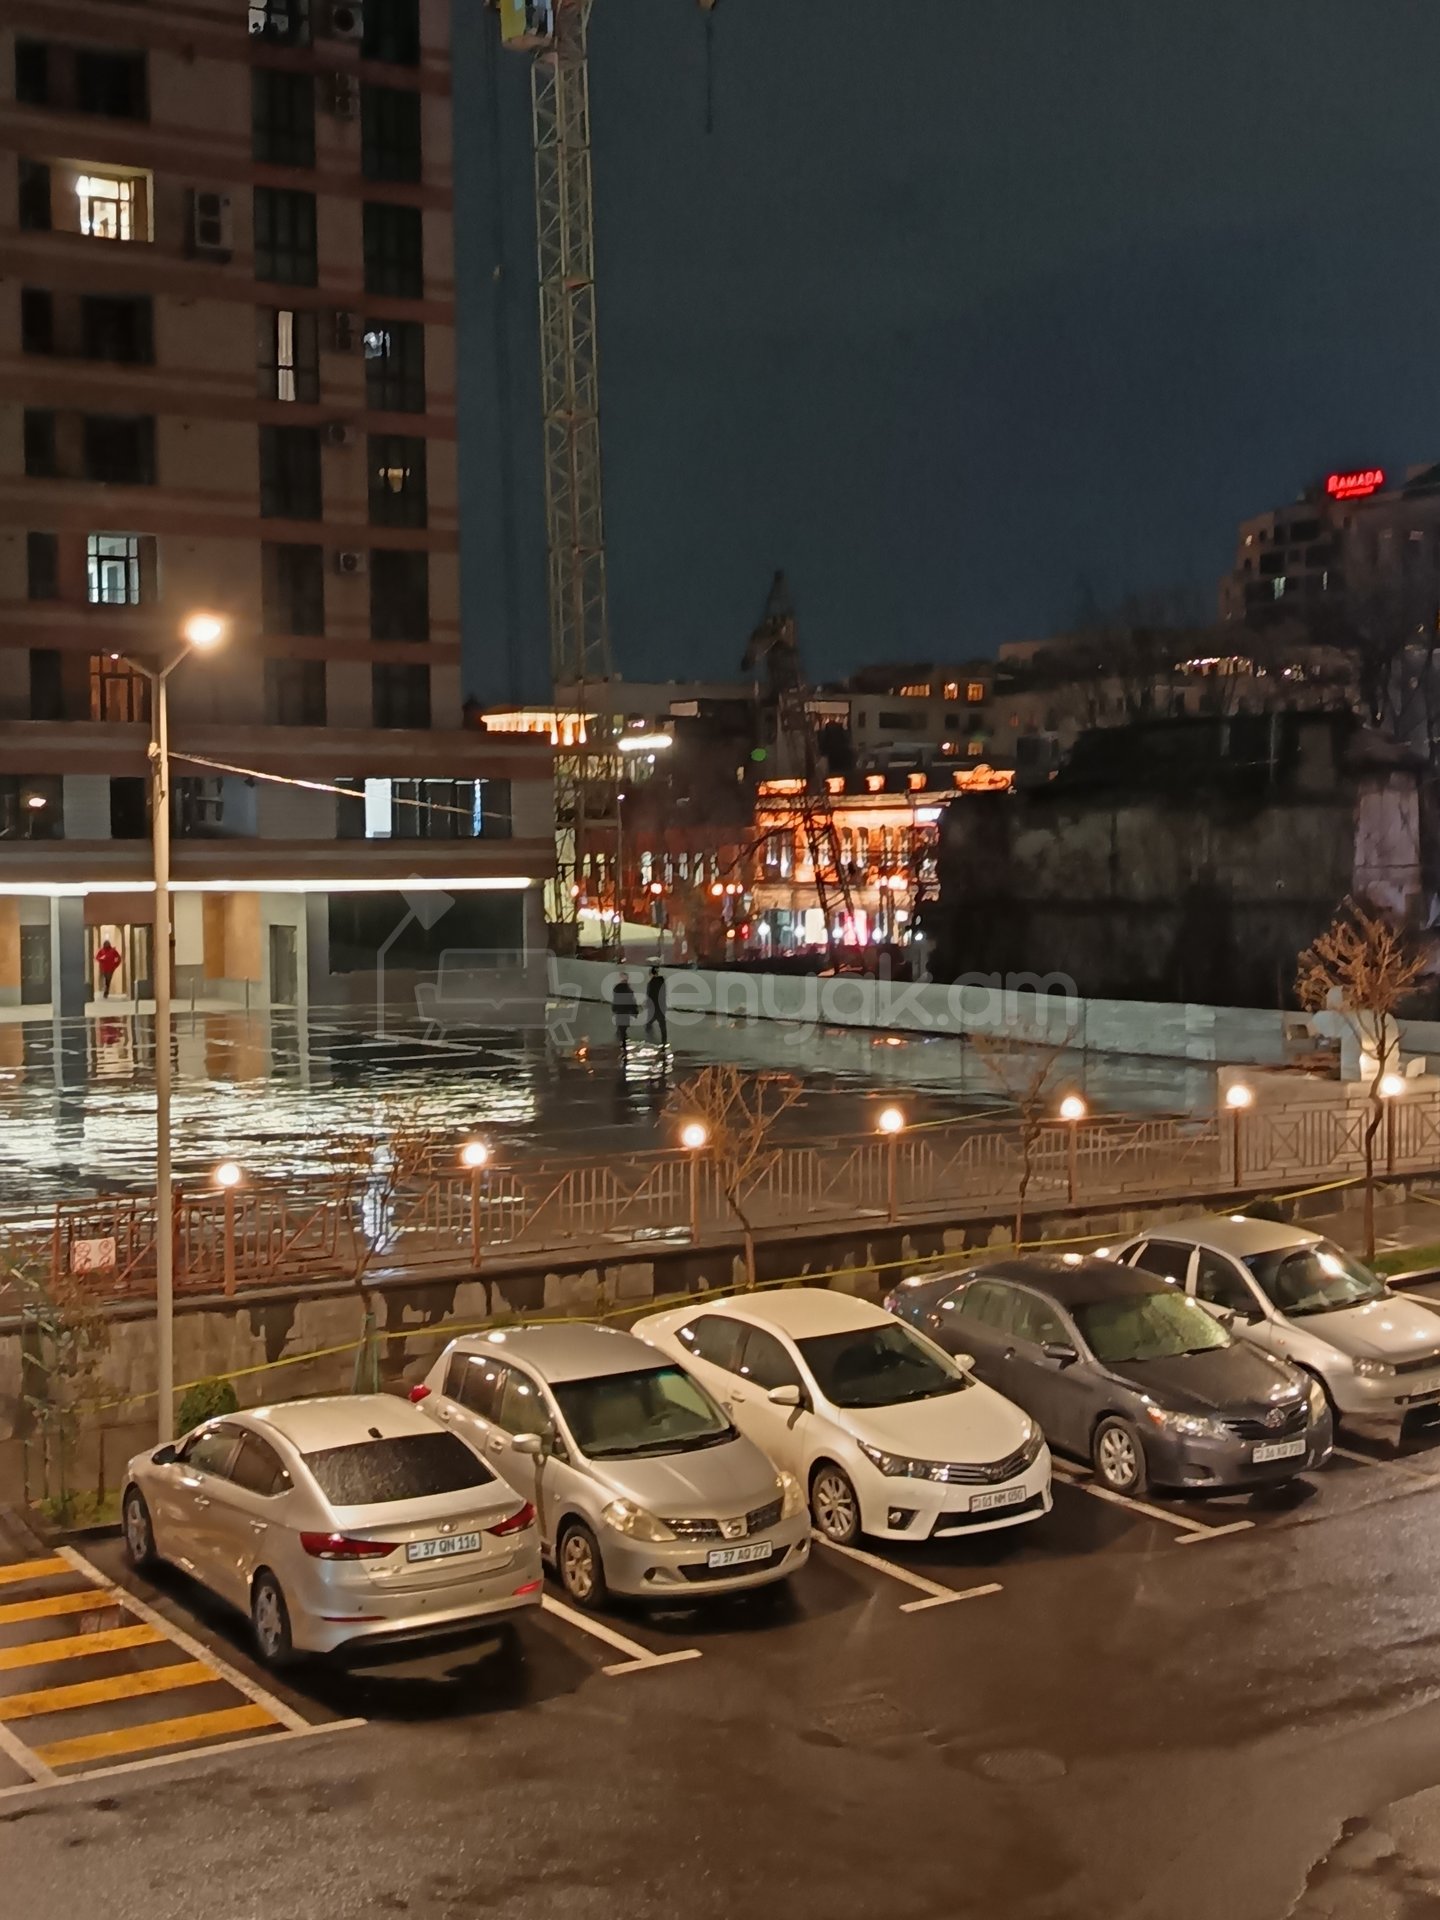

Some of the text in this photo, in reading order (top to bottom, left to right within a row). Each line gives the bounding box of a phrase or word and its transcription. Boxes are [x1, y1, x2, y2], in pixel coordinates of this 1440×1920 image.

[1327, 470, 1384, 492] RAMADA
[423, 1541, 436, 1555] 37
[458, 1535, 476, 1549] 116
[723, 1551, 734, 1563] 37
